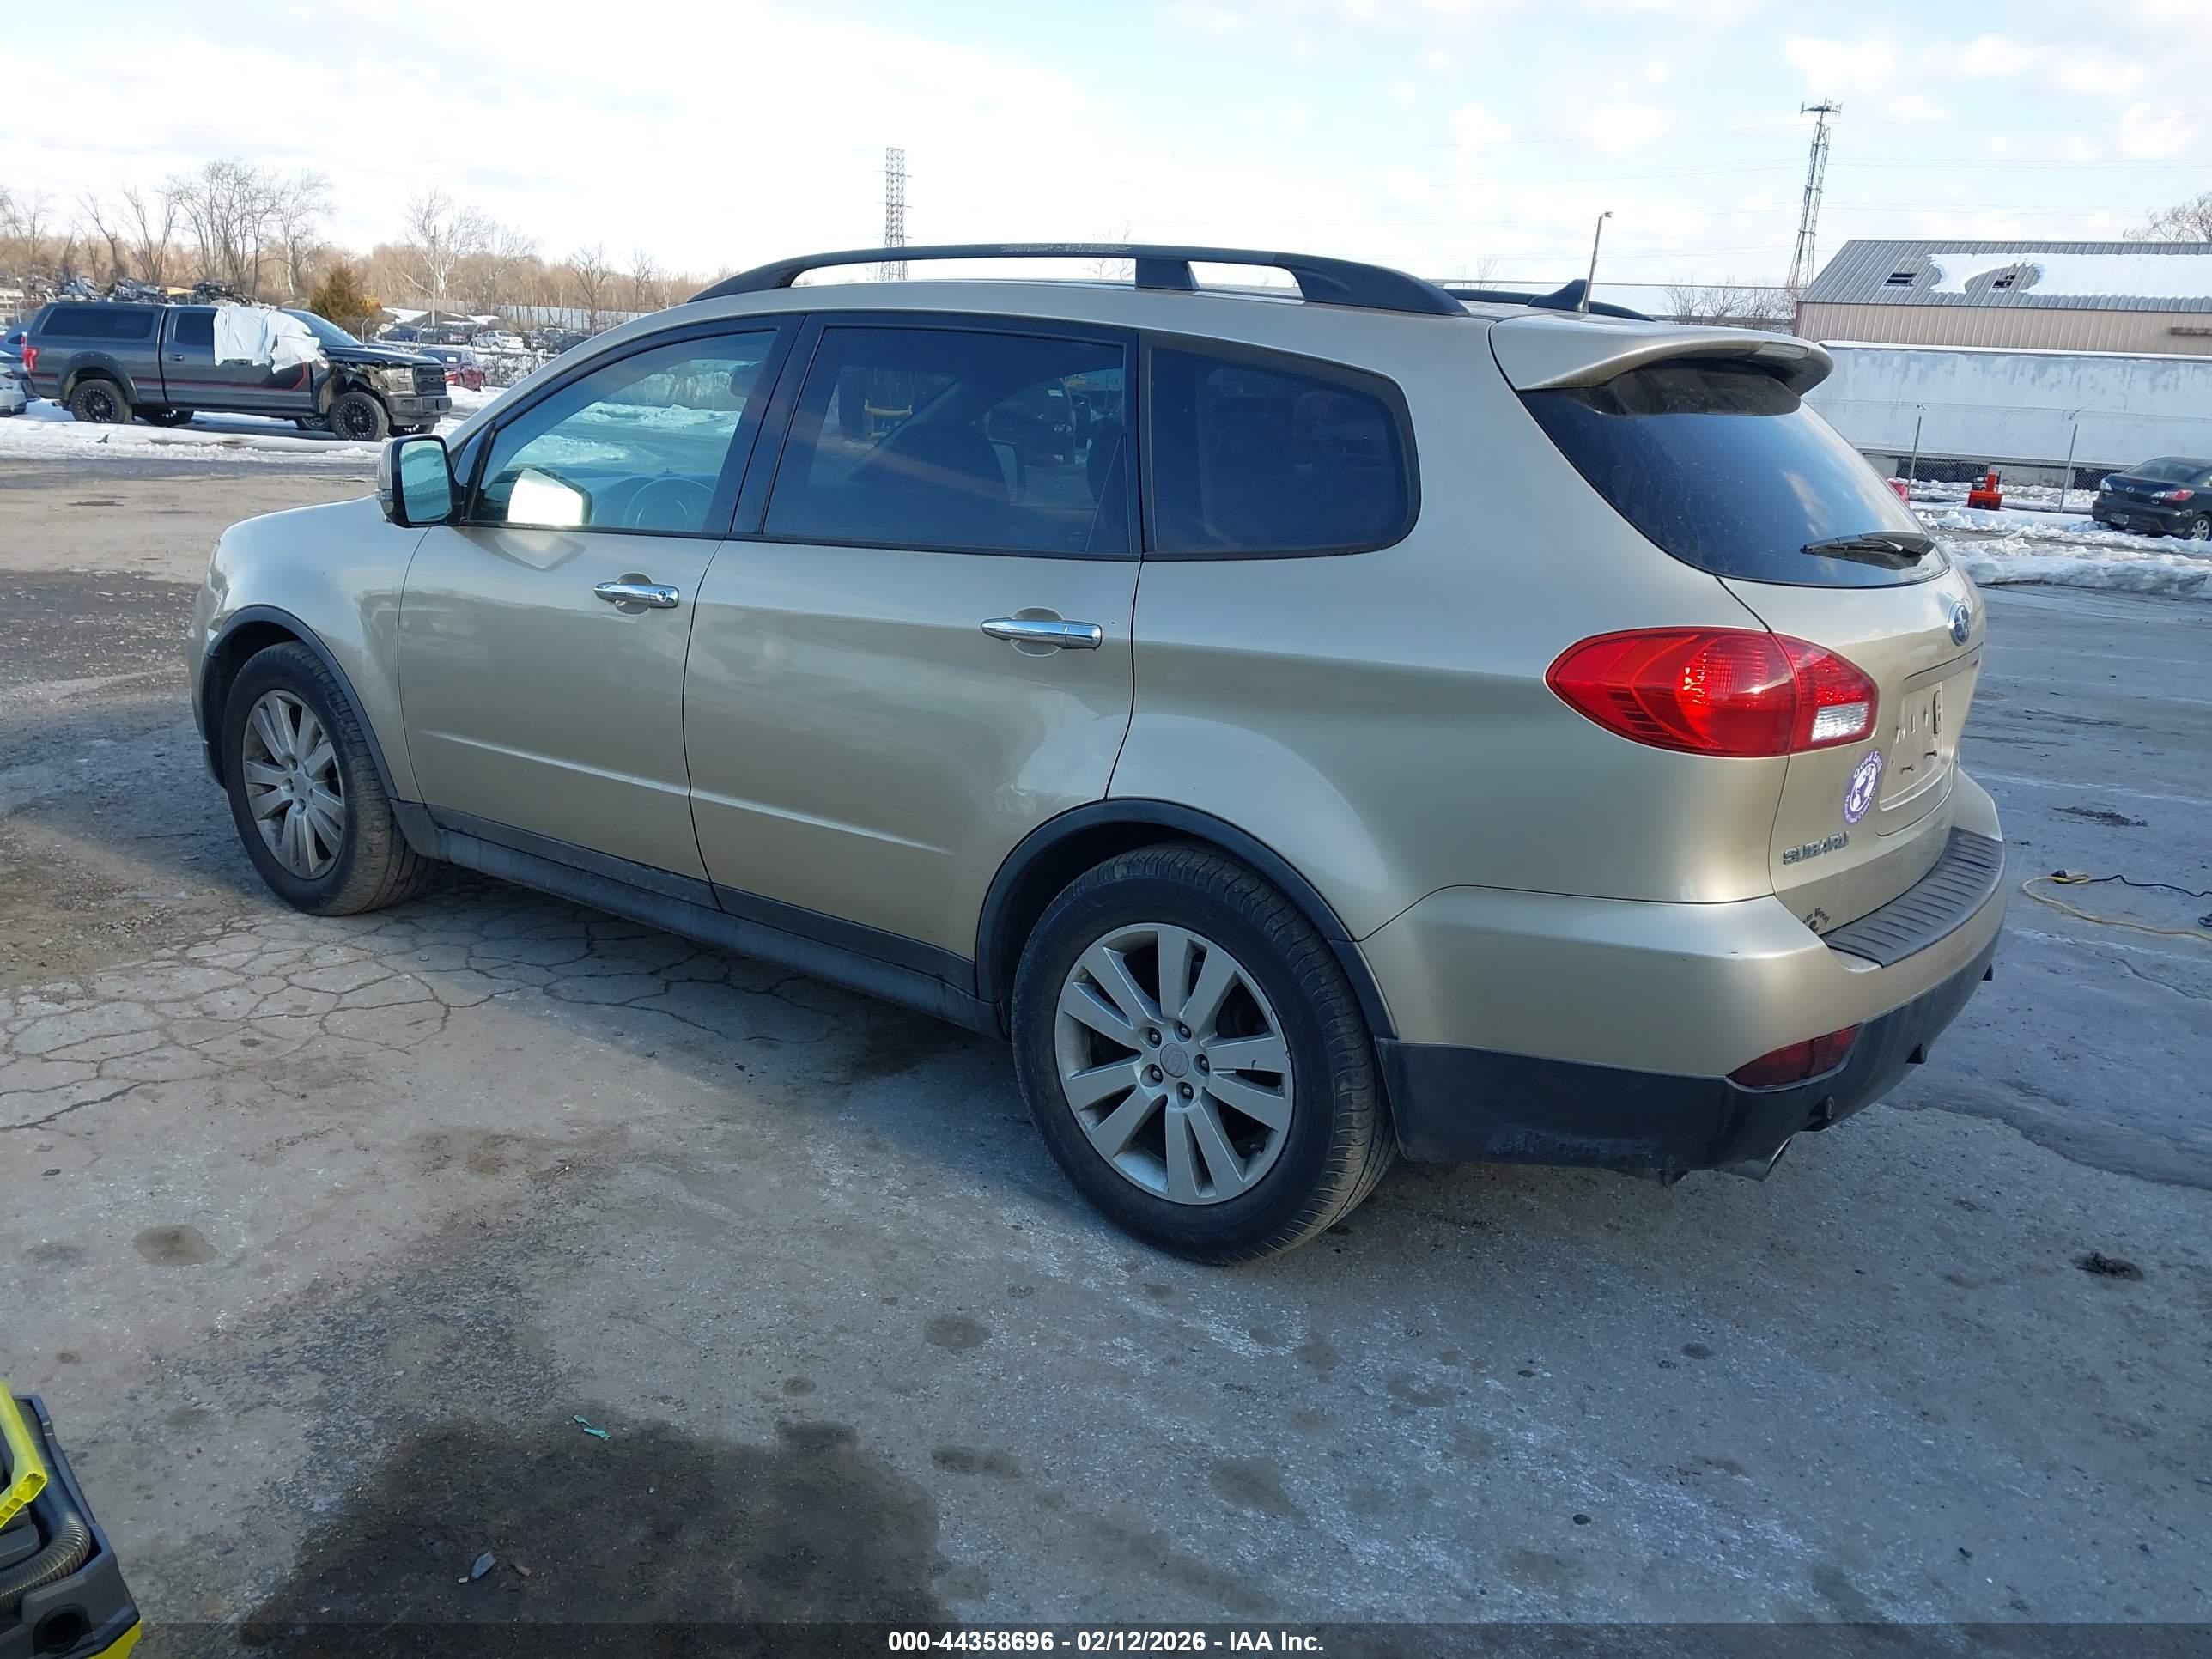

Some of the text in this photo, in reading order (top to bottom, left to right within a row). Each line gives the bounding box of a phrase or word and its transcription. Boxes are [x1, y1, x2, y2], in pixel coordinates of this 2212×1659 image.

[1853, 750, 1883, 779] Good Earth
[1782, 830, 1850, 866] SUBARU
